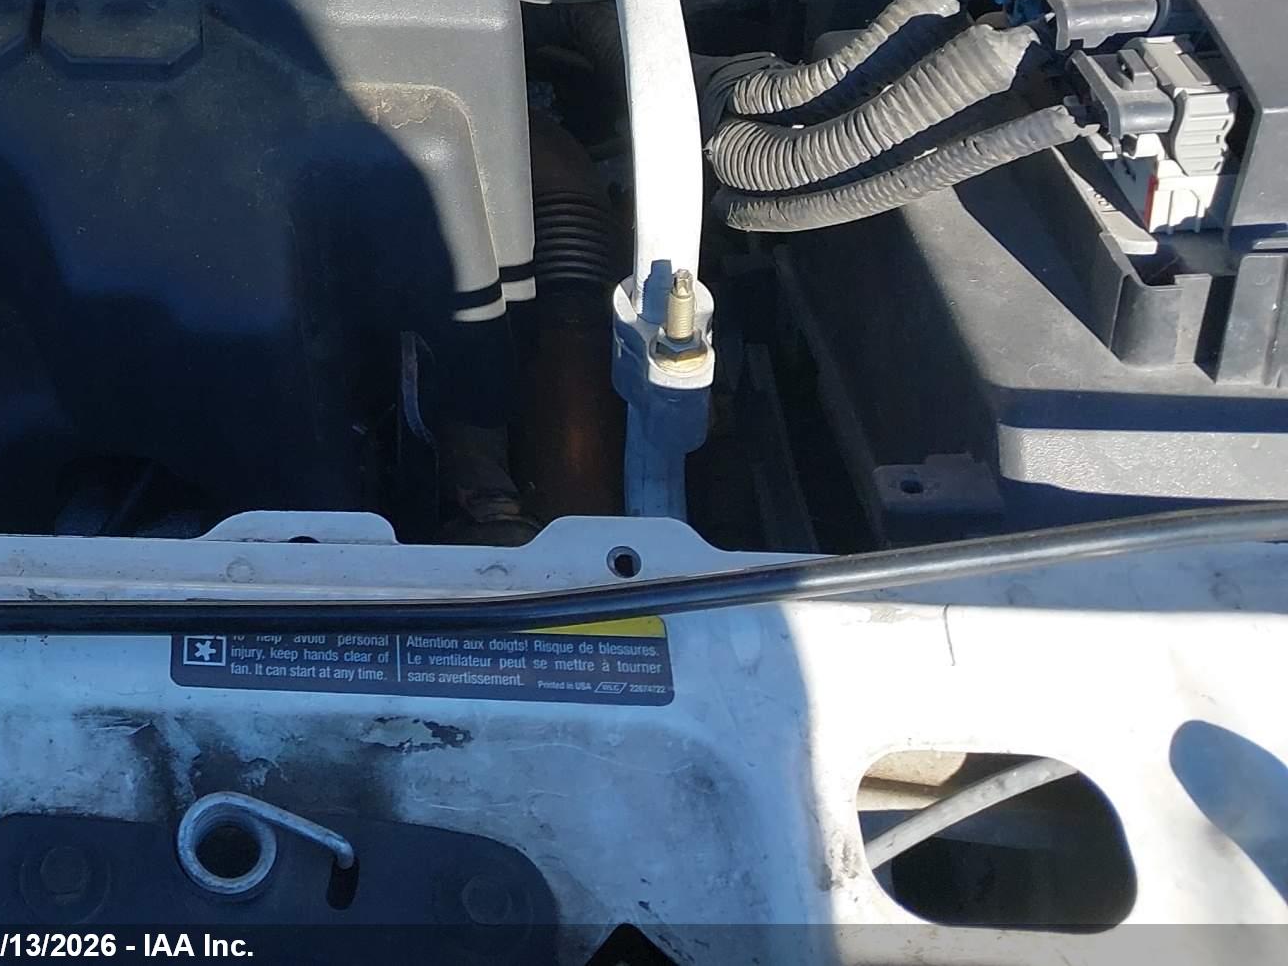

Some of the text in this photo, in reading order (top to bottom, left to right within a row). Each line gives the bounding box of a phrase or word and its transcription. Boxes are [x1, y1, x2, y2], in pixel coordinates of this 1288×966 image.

[337, 635, 389, 647] personal
[406, 635, 659, 656] Attention aux doigts! Risque de blessures.
[270, 647, 297, 662] keep
[303, 648, 338, 661] hands
[344, 650, 371, 662] clear
[378, 651, 389, 663] of
[407, 652, 662, 674] Le ventilateur peut se mettre à tourner
[231, 663, 387, 681] fan. It can start at any time.
[407, 672, 525, 686] sans avertissement.
[575, 681, 592, 690] USA
